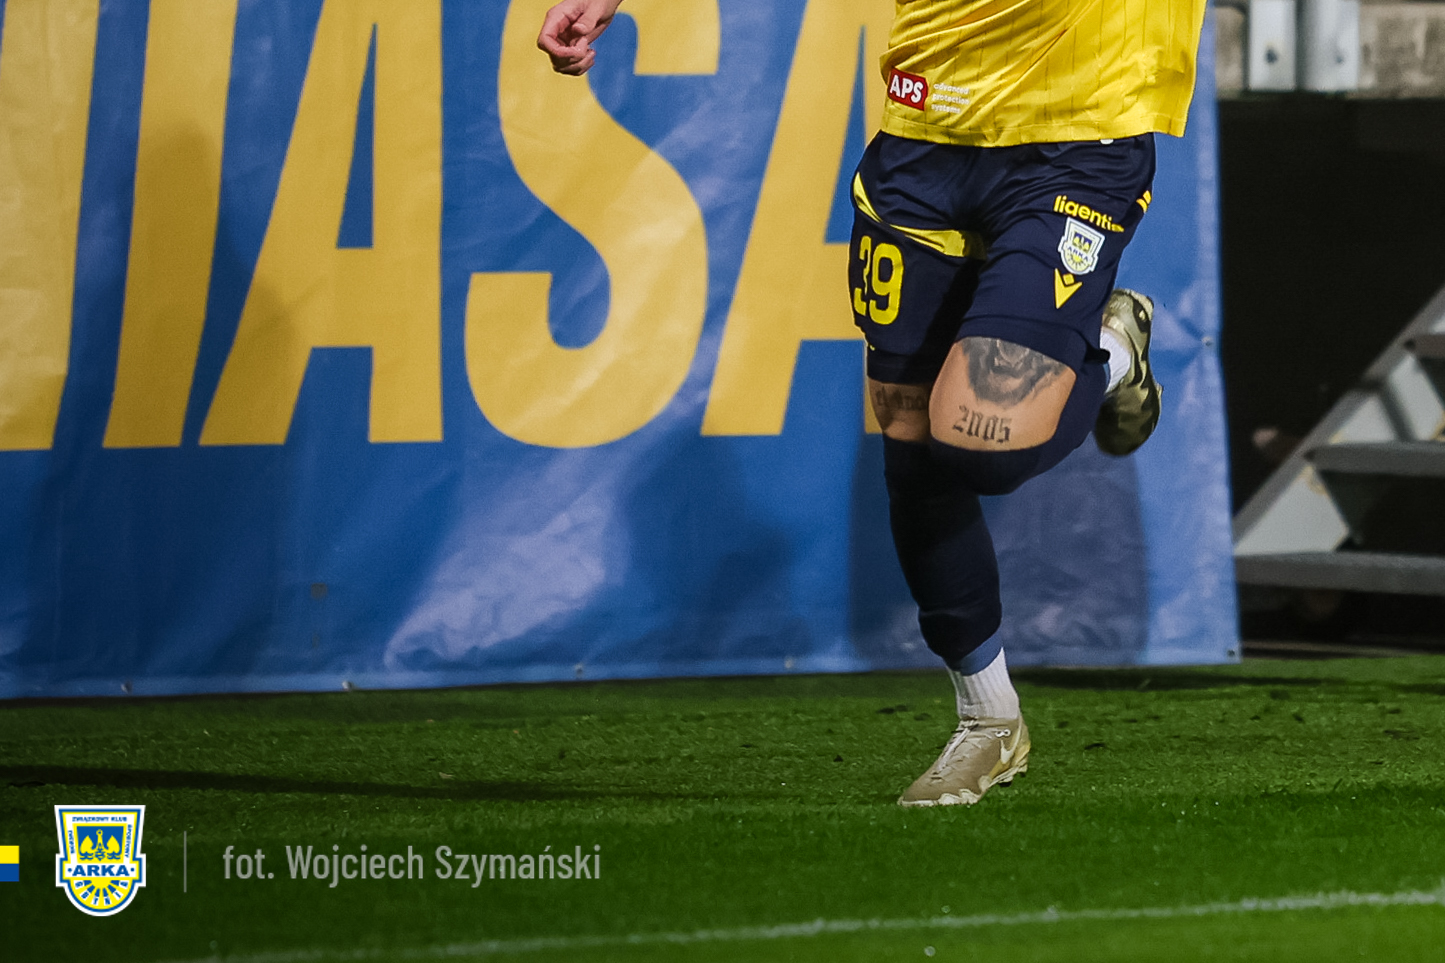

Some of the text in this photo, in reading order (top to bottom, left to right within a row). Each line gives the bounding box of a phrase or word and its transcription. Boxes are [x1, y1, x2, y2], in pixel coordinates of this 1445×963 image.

[889, 74, 924, 104] APS
[932, 93, 970, 109] protection
[854, 235, 904, 325] 39
